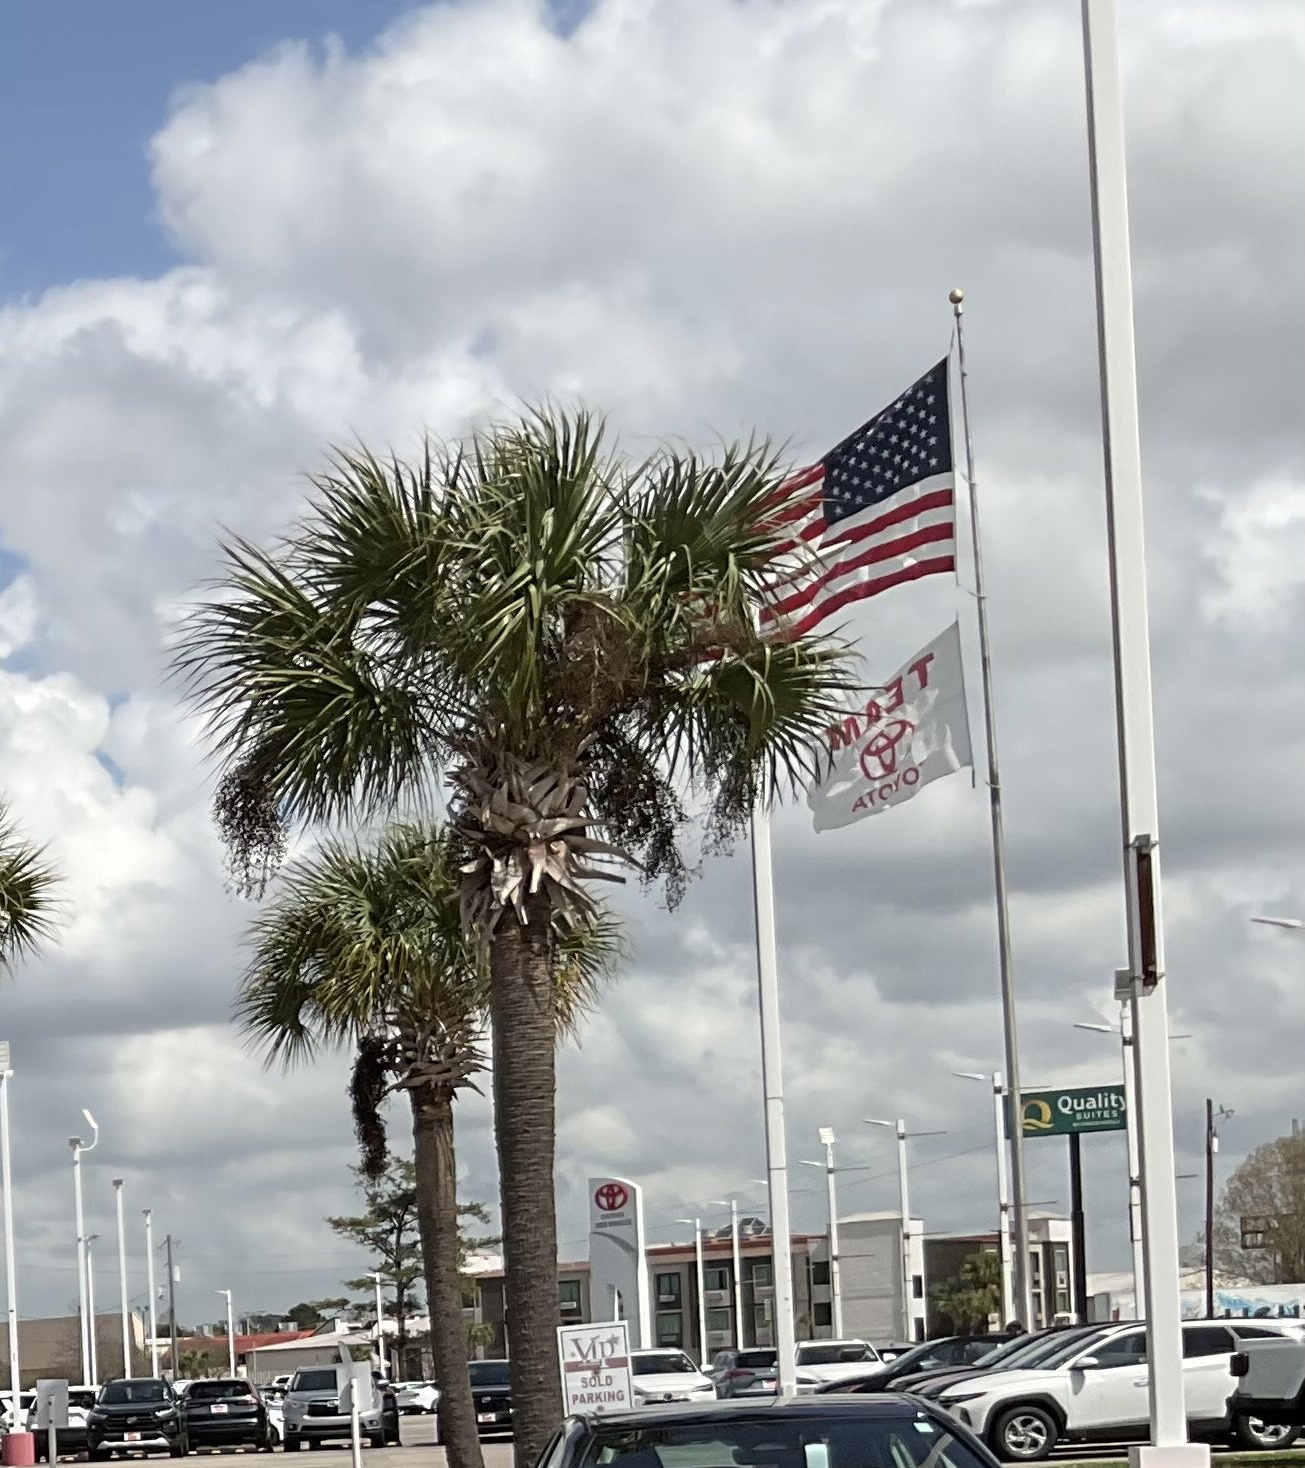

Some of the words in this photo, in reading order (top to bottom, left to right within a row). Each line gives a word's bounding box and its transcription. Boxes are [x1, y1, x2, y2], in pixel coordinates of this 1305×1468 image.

[1058, 1093, 1126, 1115] Quality
[1076, 1110, 1118, 1120] SUITES
[581, 1376, 613, 1388] SOLD
[572, 1390, 625, 1405] PARKING
